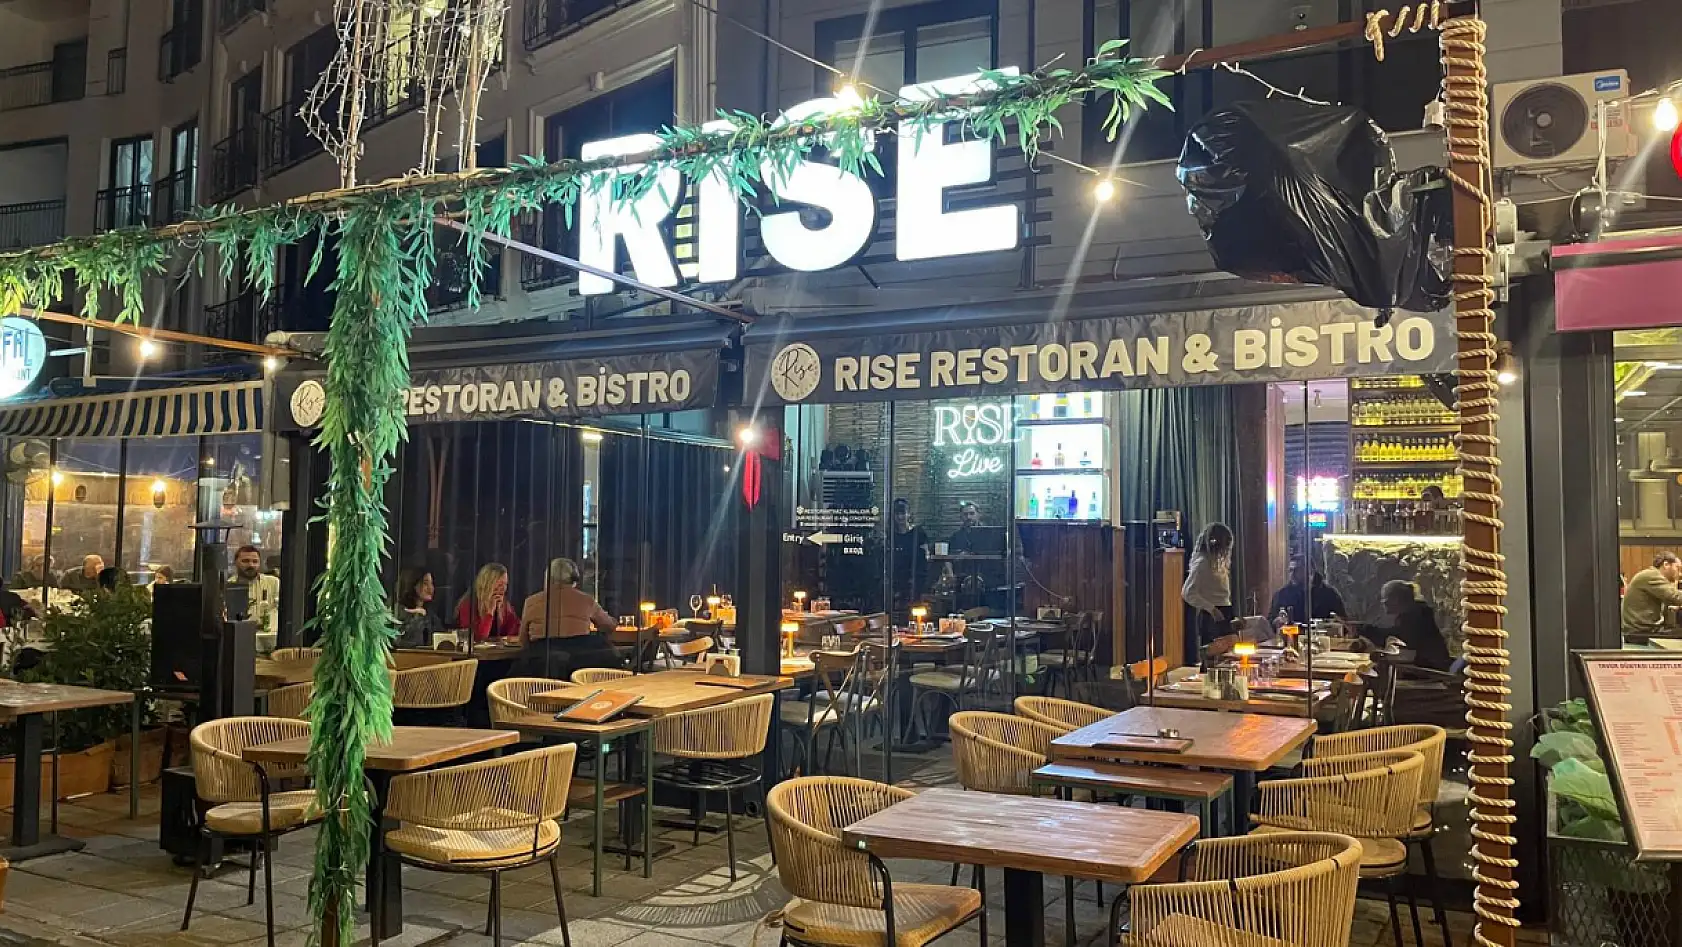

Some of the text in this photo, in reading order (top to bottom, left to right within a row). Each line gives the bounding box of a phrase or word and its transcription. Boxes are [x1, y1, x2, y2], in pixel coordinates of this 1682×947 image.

[579, 66, 1019, 295] RISE
[834, 317, 1435, 391] RISE RESTORAN & BİSTRO
[548, 376, 569, 408] &
[576, 366, 691, 407] BİSTRO
[933, 403, 1024, 446] RISE
[947, 448, 1003, 478] Live
[783, 533, 805, 545] Entry
[844, 534, 864, 545] Giriş
